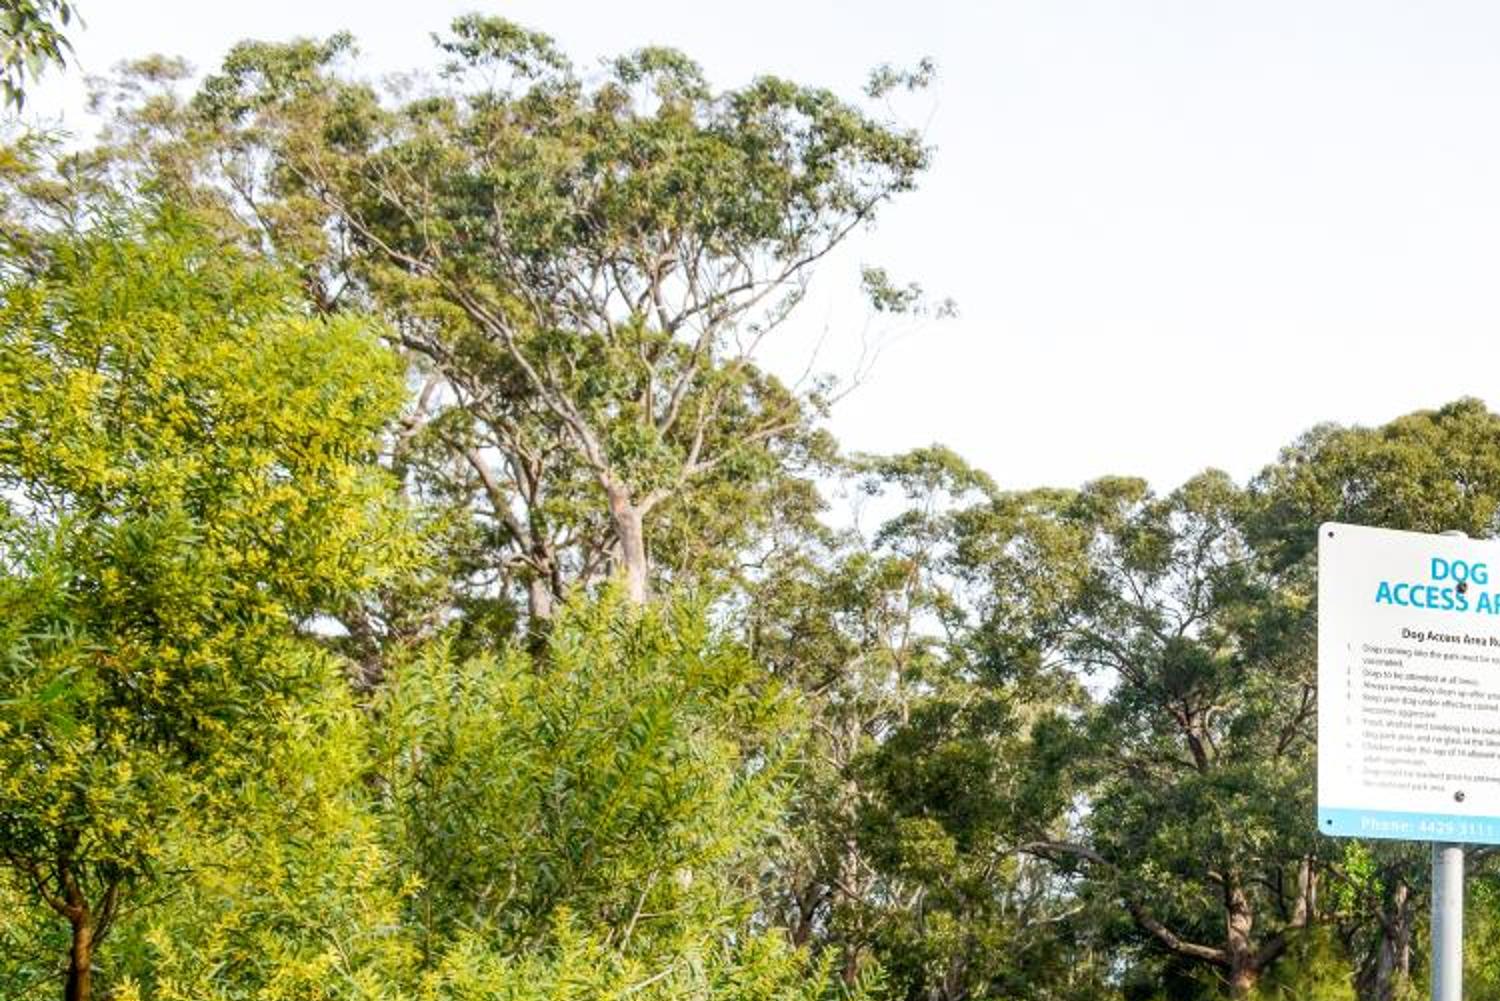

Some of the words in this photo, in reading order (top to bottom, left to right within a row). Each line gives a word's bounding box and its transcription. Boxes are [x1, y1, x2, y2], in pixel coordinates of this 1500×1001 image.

[1431, 557, 1488, 585] DOG
[1375, 580, 1467, 612] ACCESS
[1401, 627, 1424, 642] Dog
[1426, 630, 1461, 644] Access
[1463, 633, 1486, 646] Area
